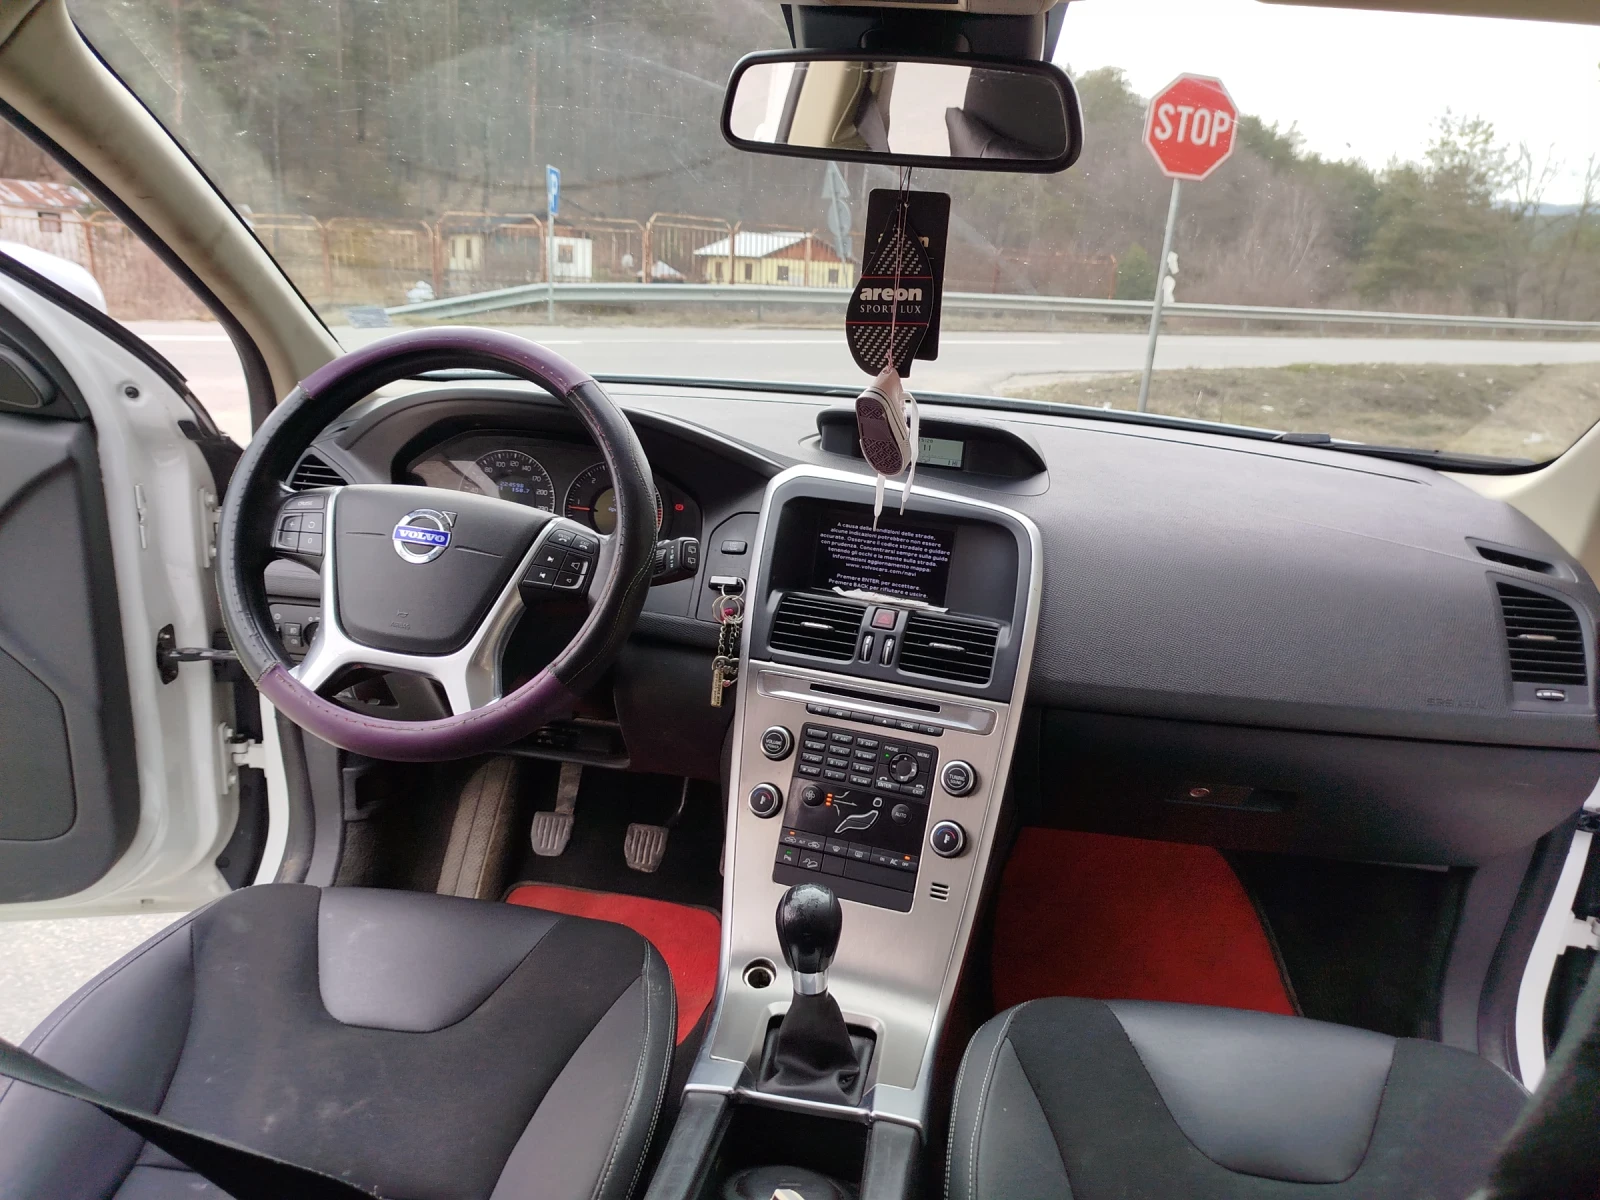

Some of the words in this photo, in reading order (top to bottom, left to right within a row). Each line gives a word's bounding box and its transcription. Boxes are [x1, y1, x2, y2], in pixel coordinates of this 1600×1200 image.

[1154, 102, 1231, 147] STOP
[860, 288, 922, 301] areon
[860, 304, 896, 313] SPORT
[900, 305, 921, 313] LUX
[398, 529, 446, 543] VOLVO
